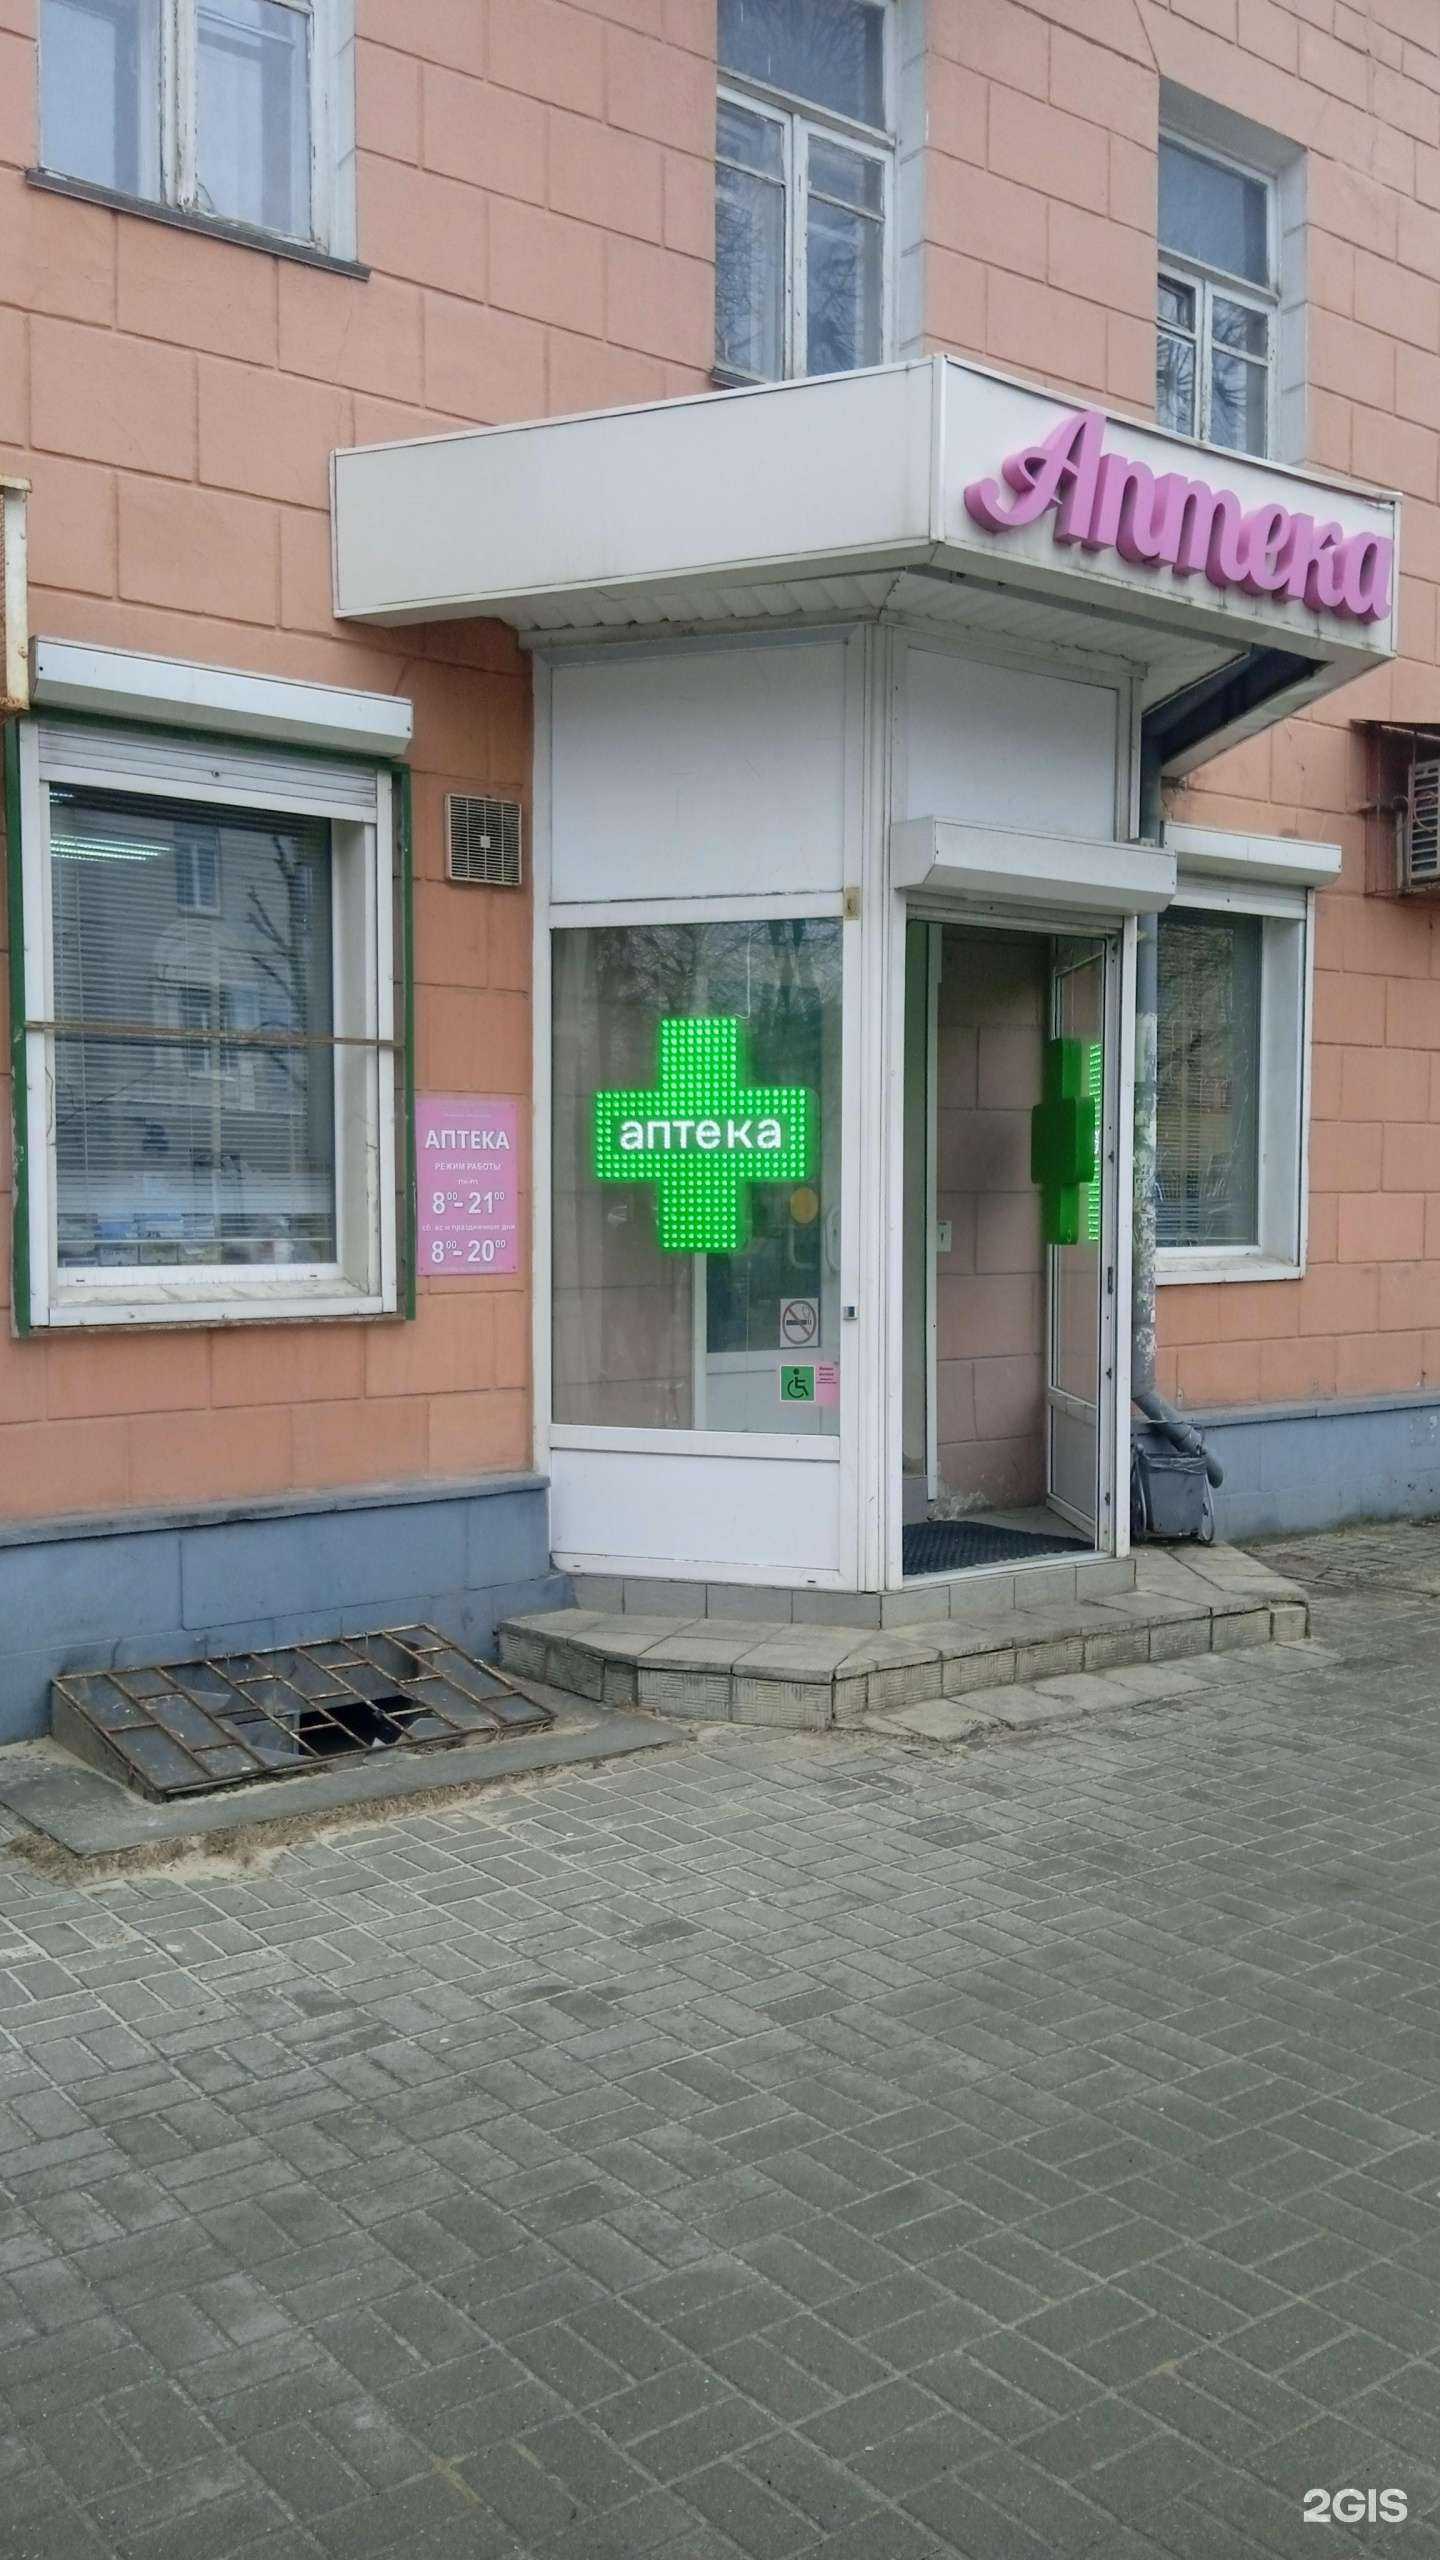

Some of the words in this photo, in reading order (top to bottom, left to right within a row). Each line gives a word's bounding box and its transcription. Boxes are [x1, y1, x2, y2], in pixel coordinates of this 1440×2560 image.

[964, 410, 1392, 624] Аптека
[425, 1129, 510, 1150] АПТЕКА
[620, 1118, 782, 1150] аптека
